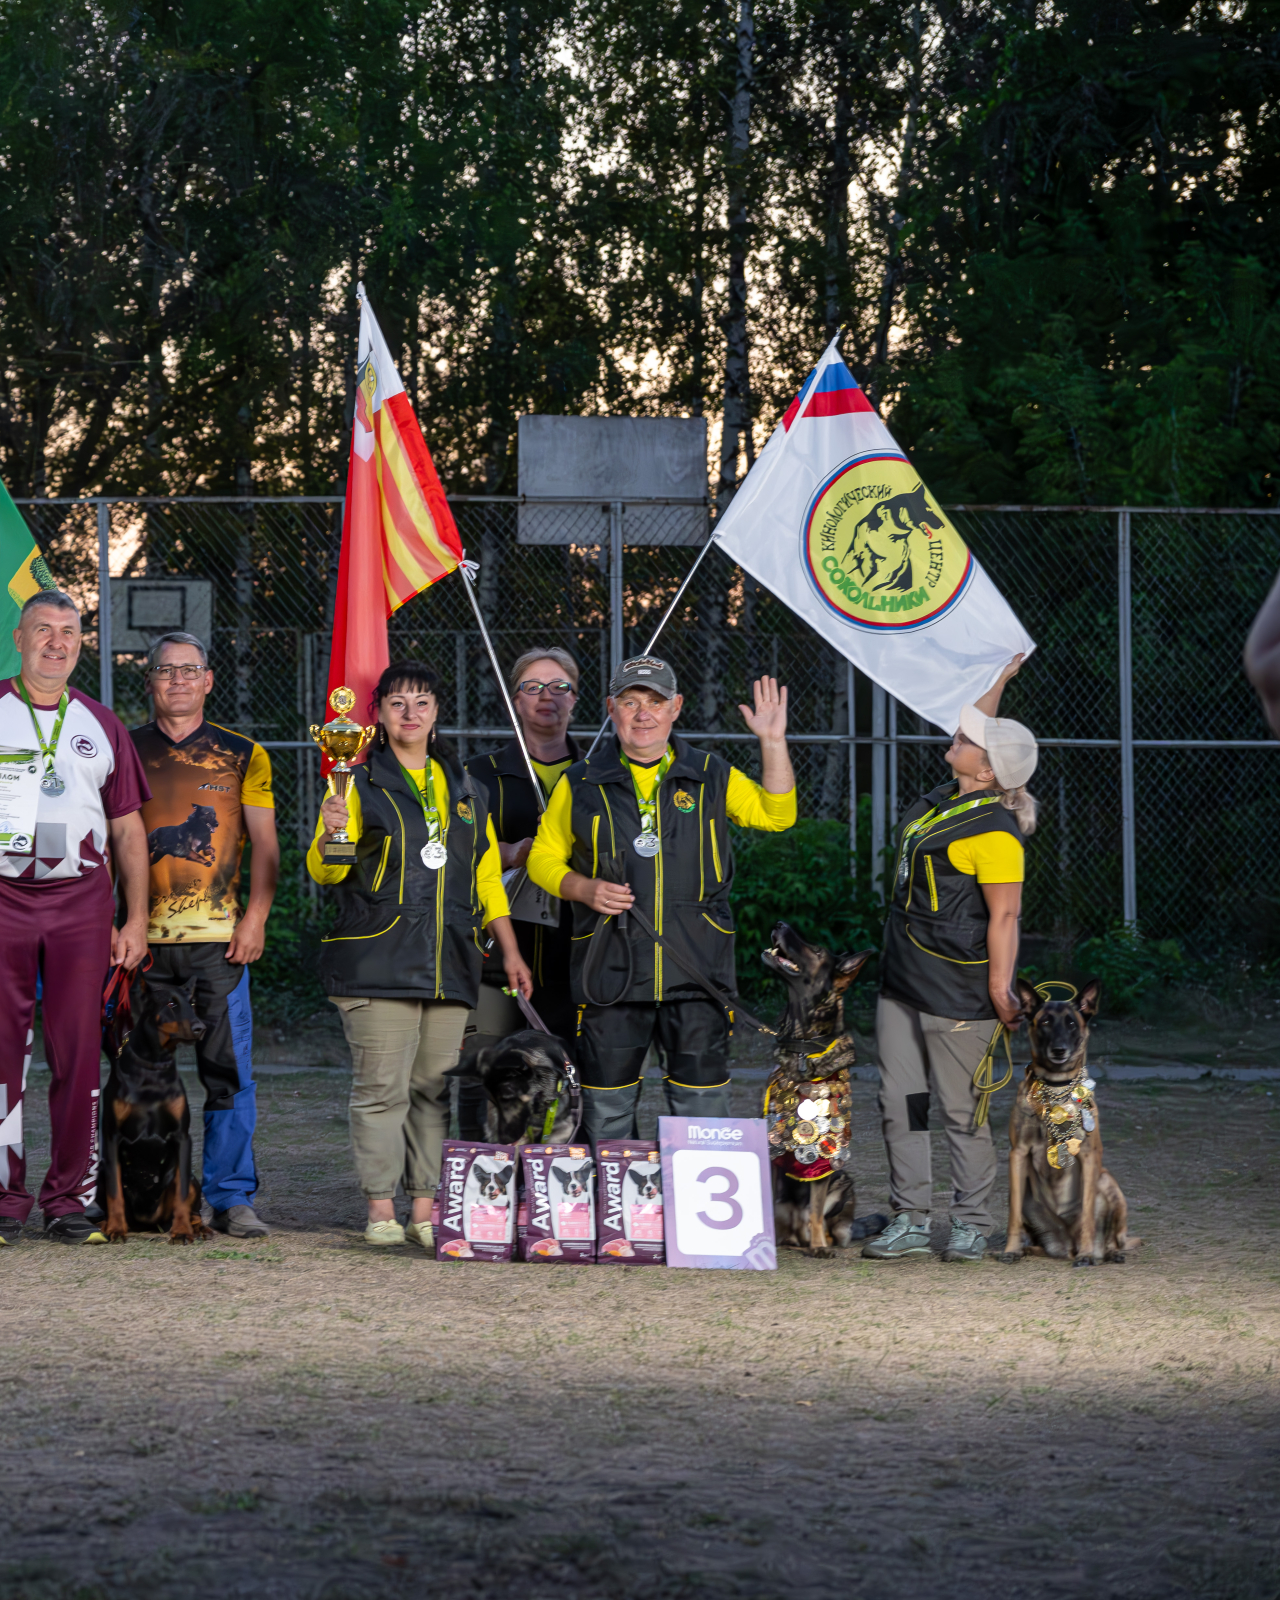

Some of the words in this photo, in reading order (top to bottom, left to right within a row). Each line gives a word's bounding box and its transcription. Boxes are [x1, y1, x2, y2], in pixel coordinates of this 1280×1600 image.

[820, 484, 893, 551] КИНОЛОГИЧЕСКИЙ
[925, 539, 944, 588] ЦЕНТР
[821, 555, 931, 612] СОКОЛЬНИКИ
[443, 1156, 467, 1232] Award
[526, 1158, 551, 1231] Award
[603, 1161, 623, 1231] Award
[695, 1166, 744, 1231] 3
